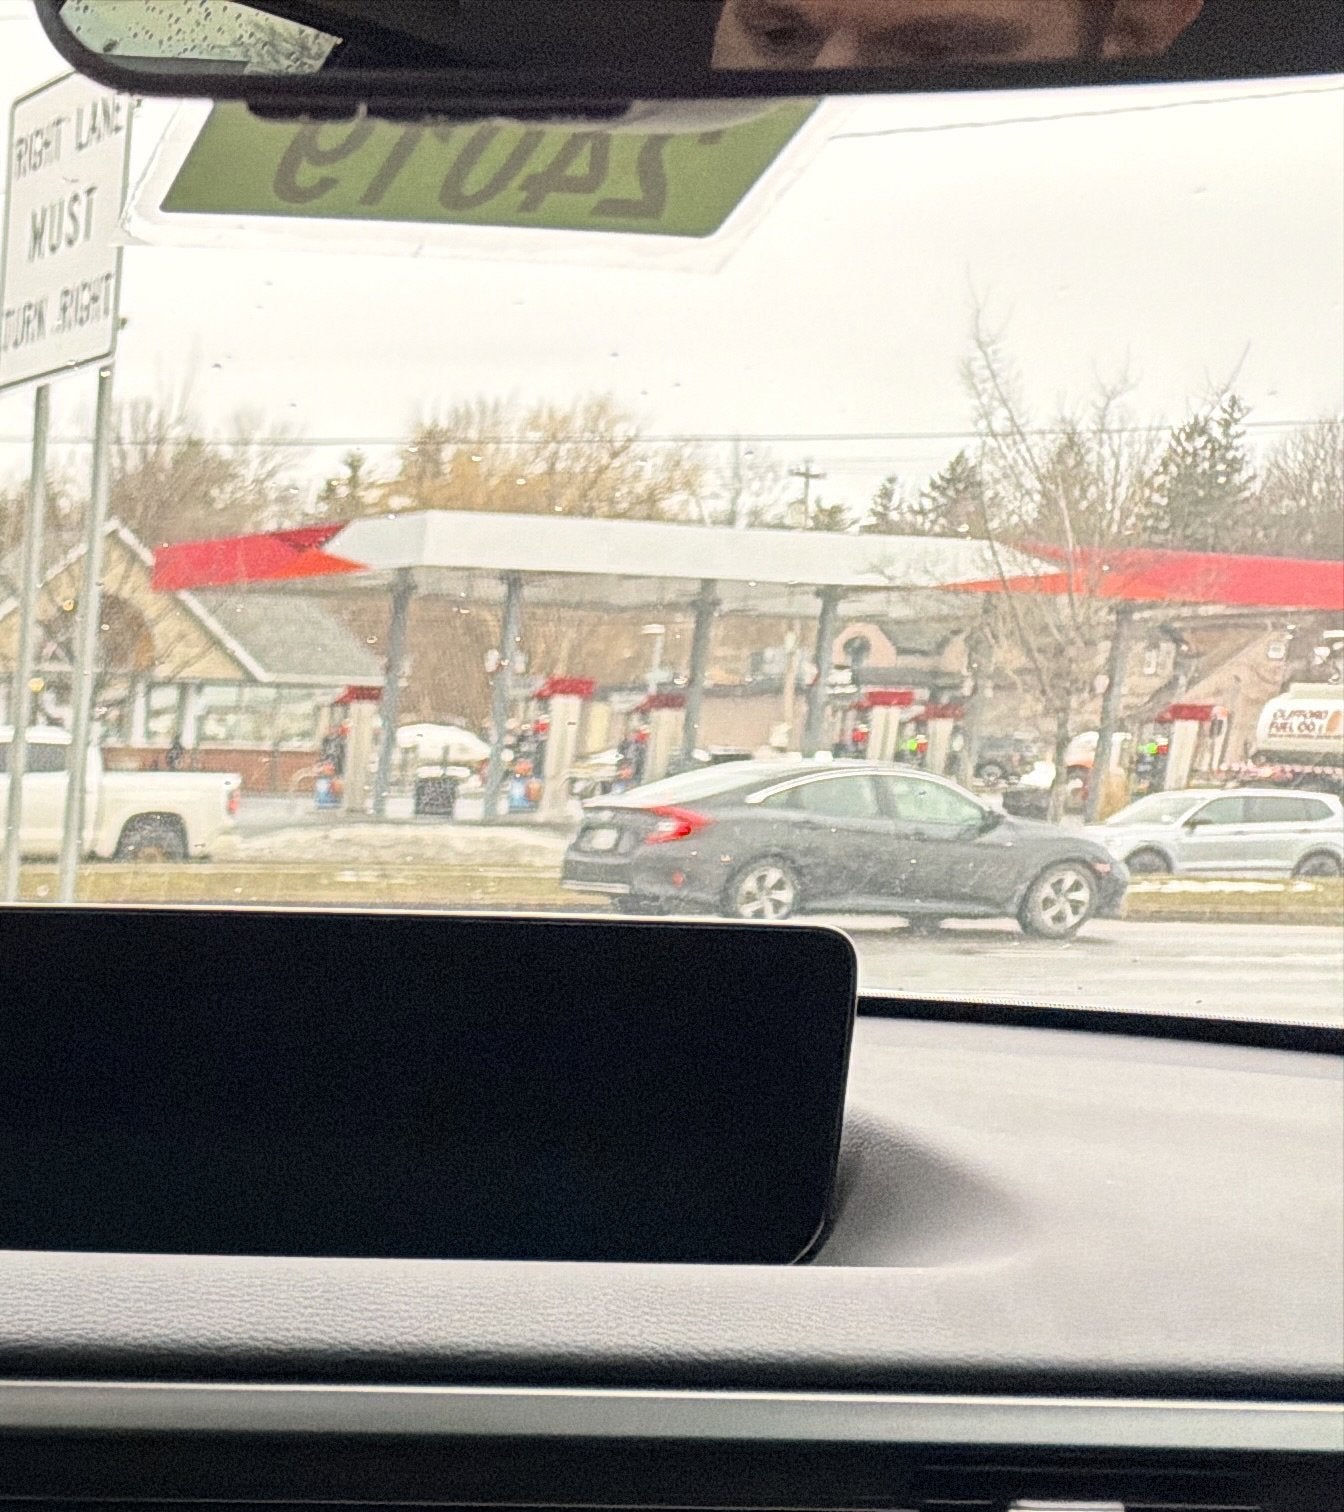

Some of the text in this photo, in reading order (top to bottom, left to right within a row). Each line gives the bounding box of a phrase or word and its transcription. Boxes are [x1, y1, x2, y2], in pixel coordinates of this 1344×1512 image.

[15, 96, 123, 180] RIGHT LANE
[27, 186, 98, 262] MUST
[2, 273, 112, 351] TURN RIGHT
